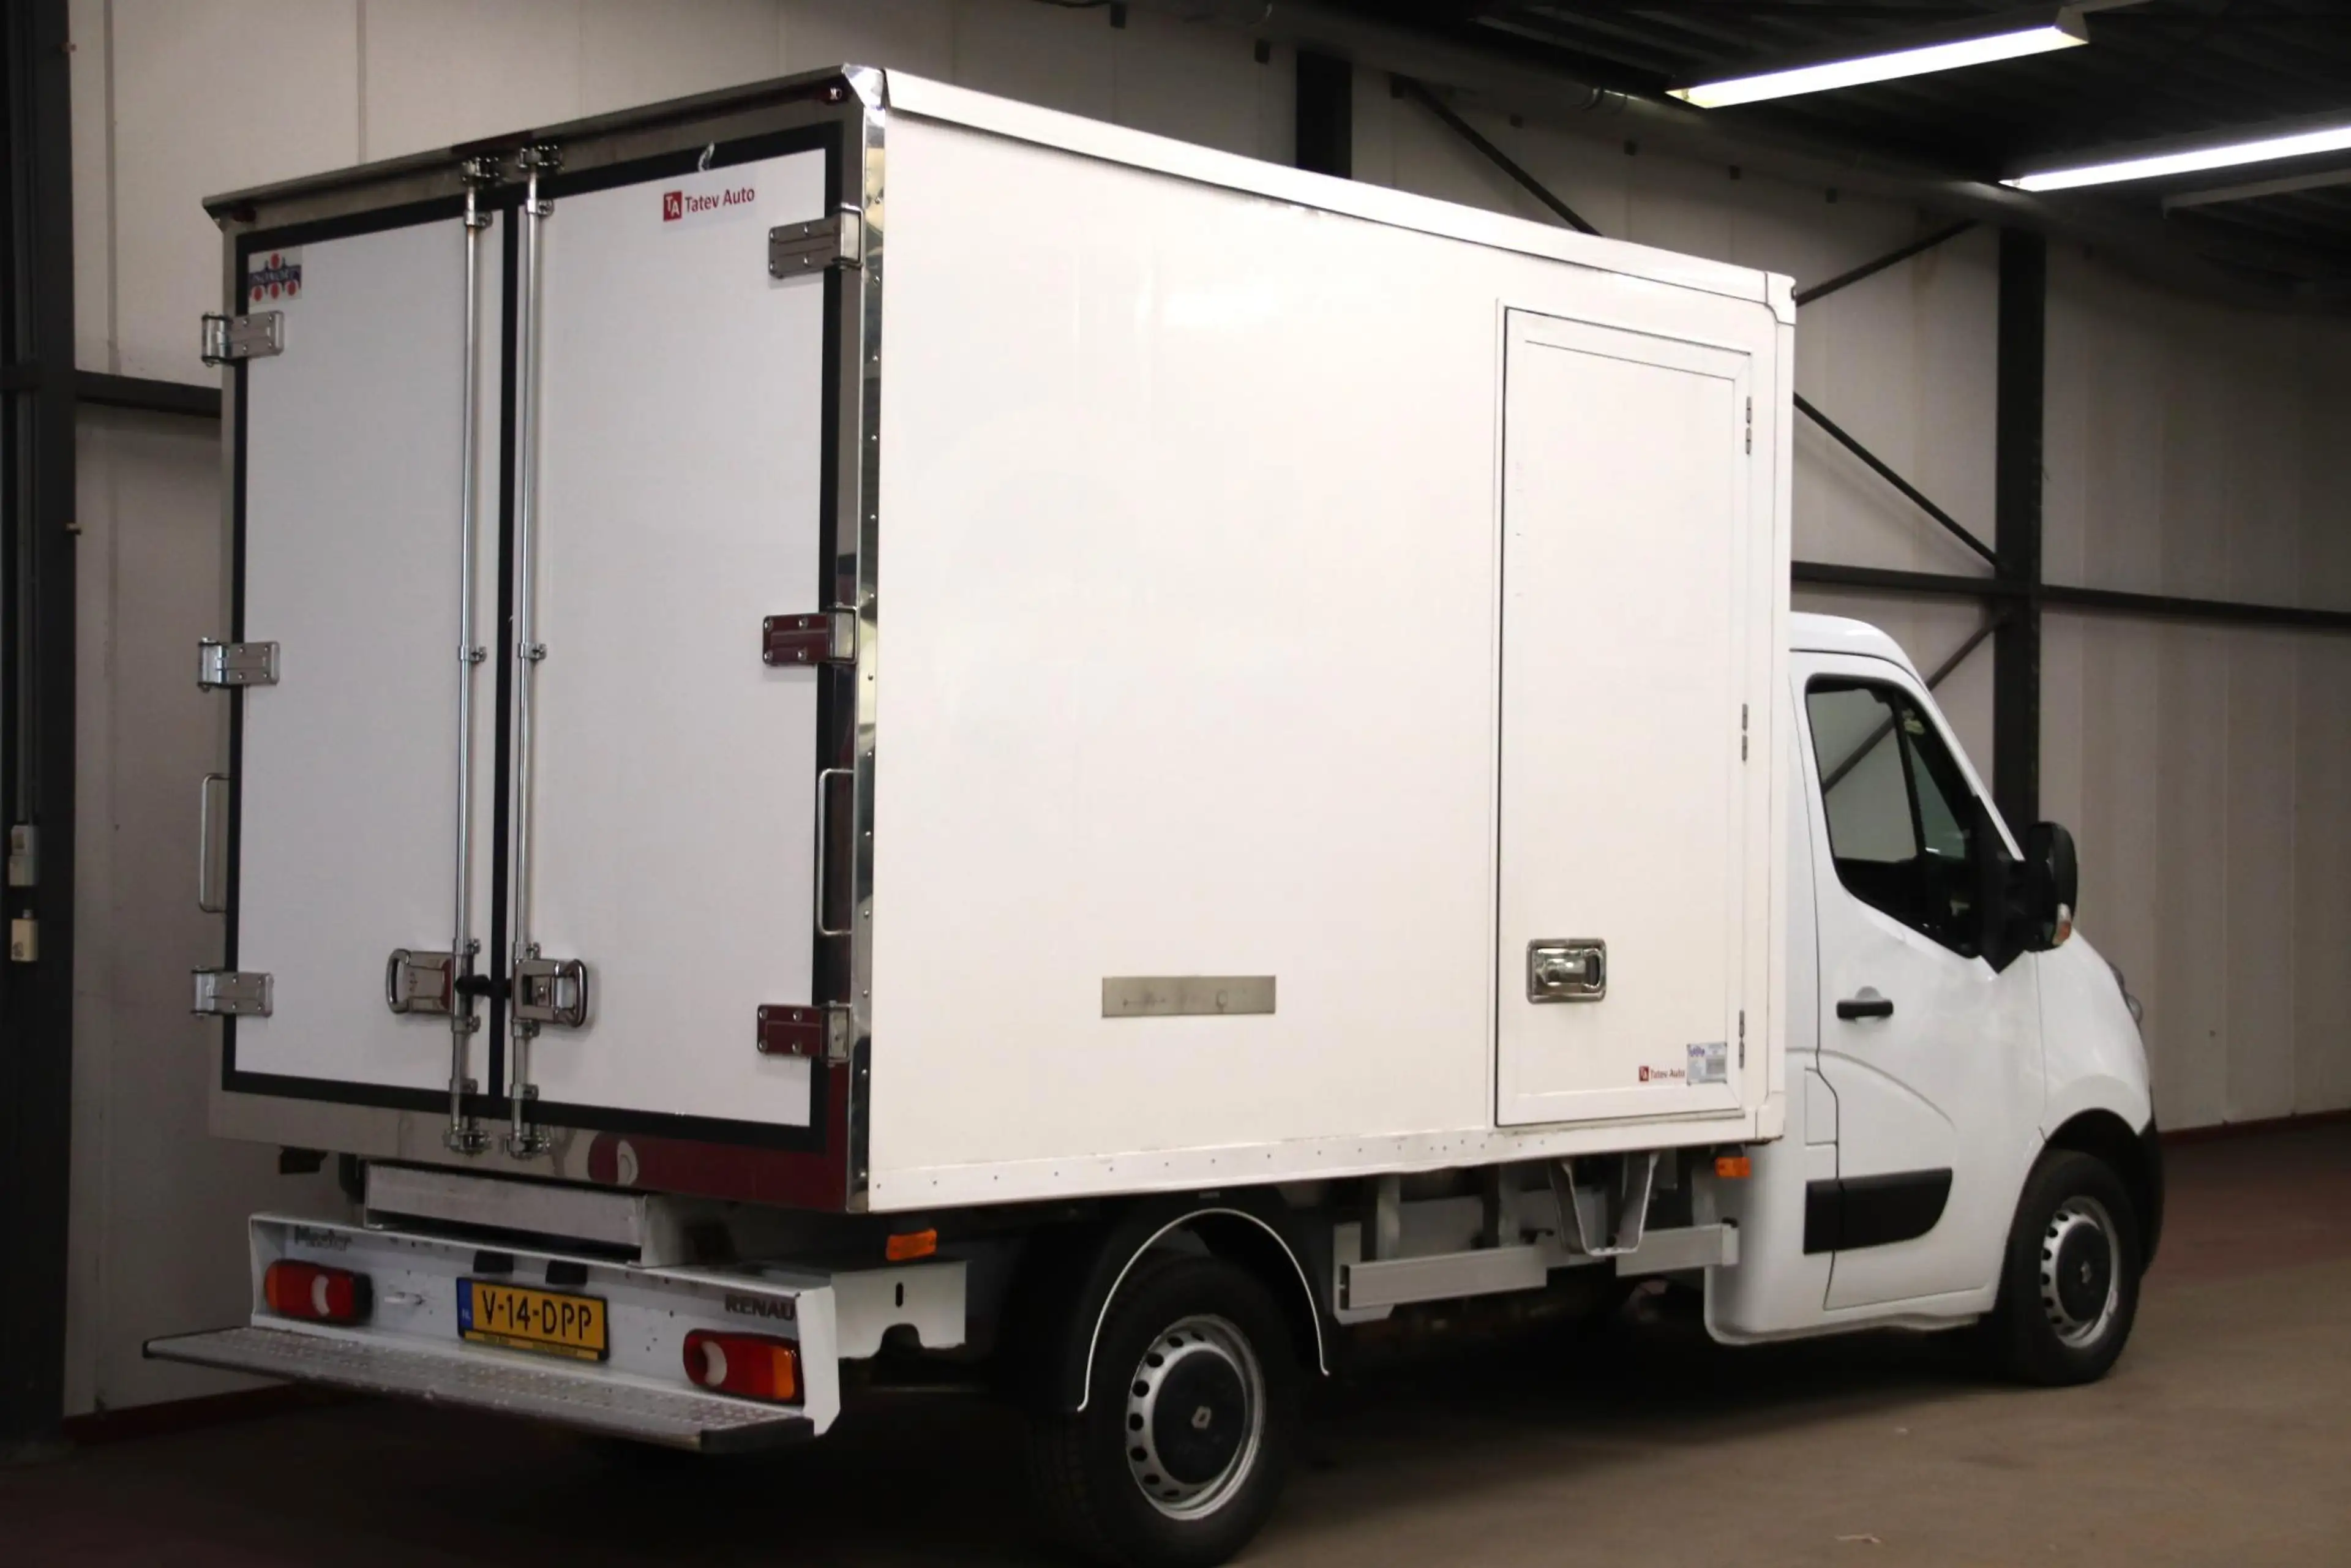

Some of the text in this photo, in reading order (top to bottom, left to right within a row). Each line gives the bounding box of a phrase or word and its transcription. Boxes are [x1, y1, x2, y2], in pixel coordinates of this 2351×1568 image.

[685, 195, 719, 213] Tatev
[723, 187, 755, 206] Auto
[1669, 1067, 1685, 1078] Auto
[481, 1289, 592, 1340] V-14-DPP
